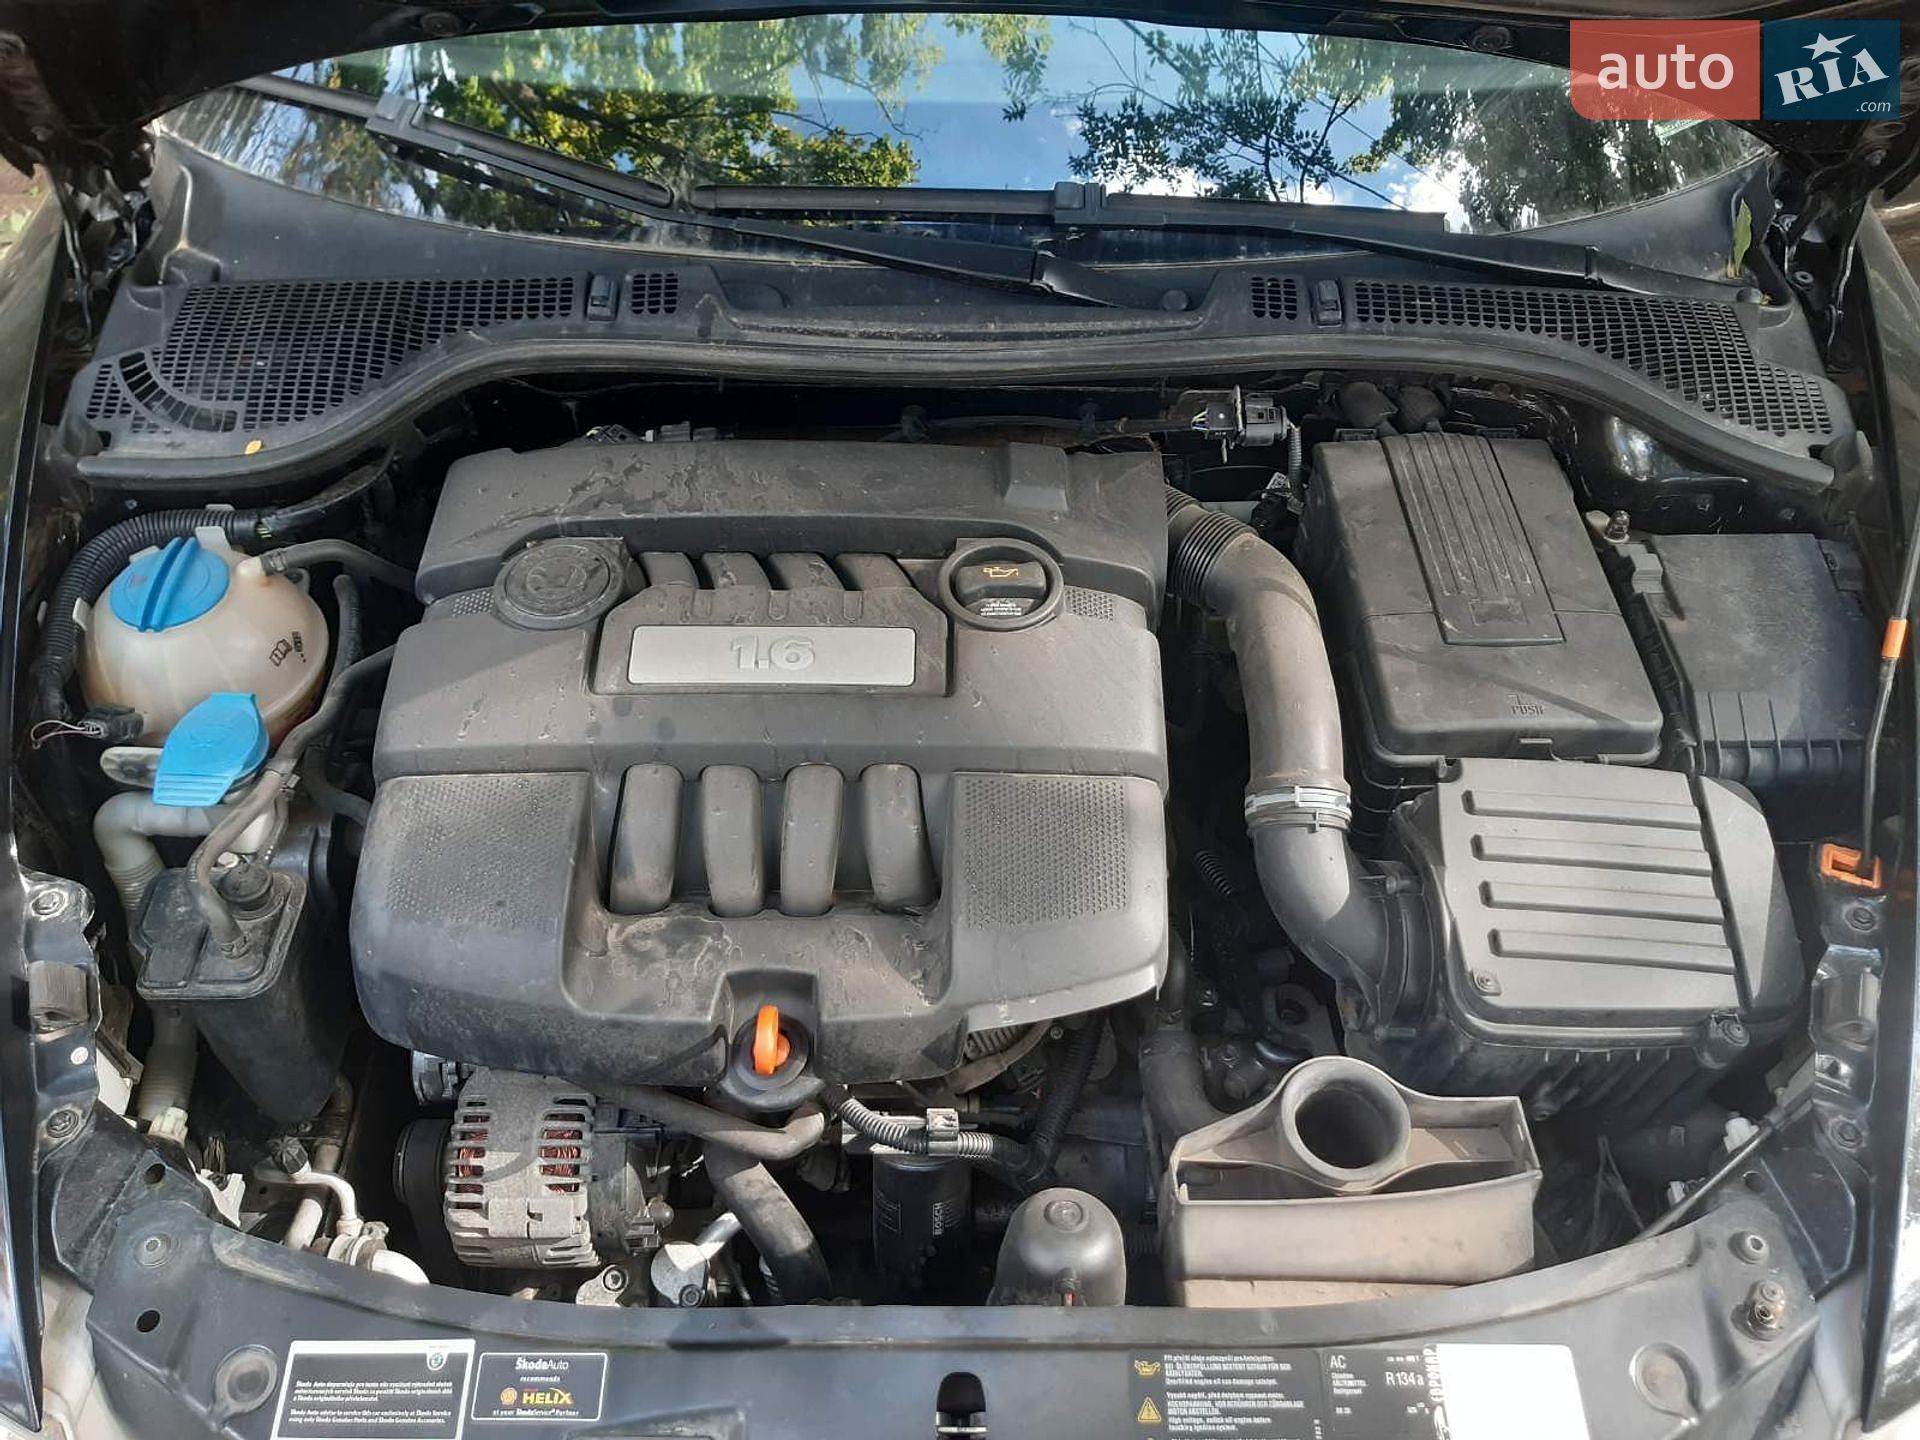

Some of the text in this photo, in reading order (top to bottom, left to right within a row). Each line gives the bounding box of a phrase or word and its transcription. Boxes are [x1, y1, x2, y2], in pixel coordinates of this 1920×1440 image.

[731, 635, 815, 671] 1.6
[1511, 704, 1544, 716] PUSH
[933, 1202, 943, 1236] BOSCH
[1329, 1354, 1347, 1369] AC
[522, 1391, 573, 1404] HELIX
